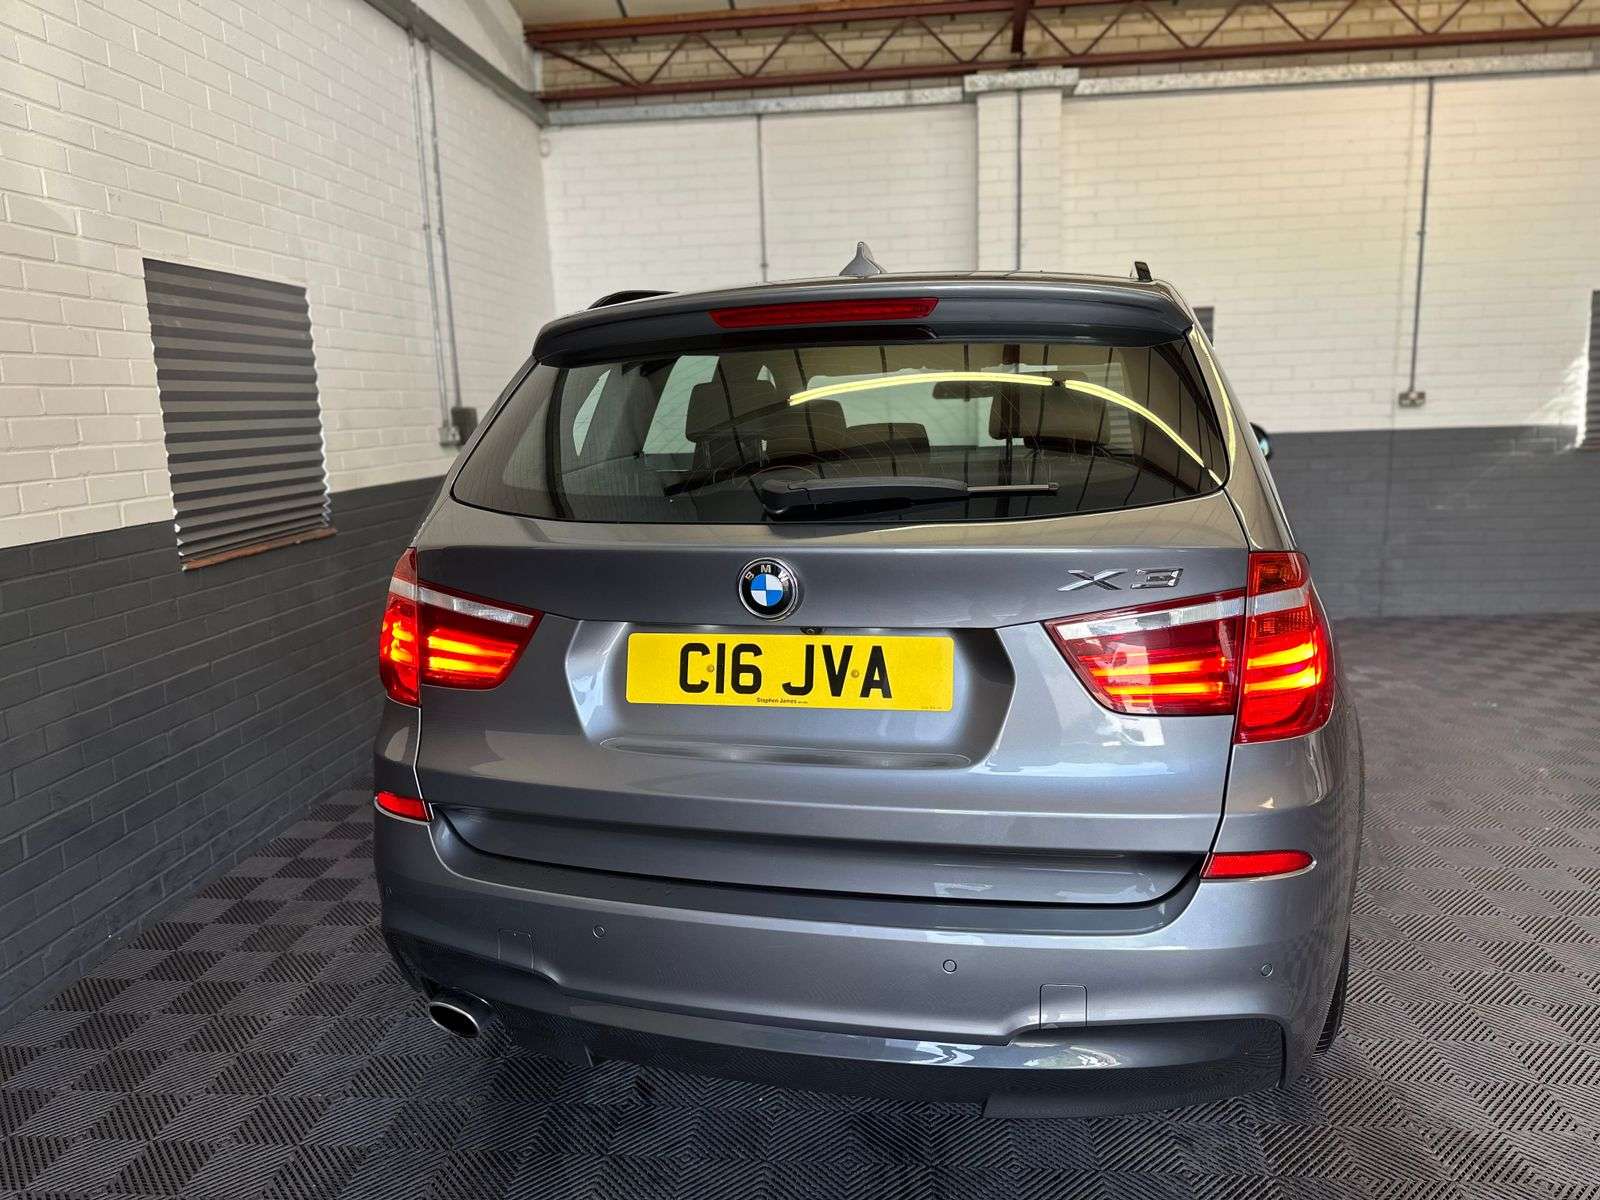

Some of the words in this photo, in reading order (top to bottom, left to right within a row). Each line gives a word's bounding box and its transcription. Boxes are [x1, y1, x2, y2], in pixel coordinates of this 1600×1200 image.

[1056, 567, 1184, 592] X3
[679, 642, 763, 694] C16
[781, 644, 893, 698] JVA
